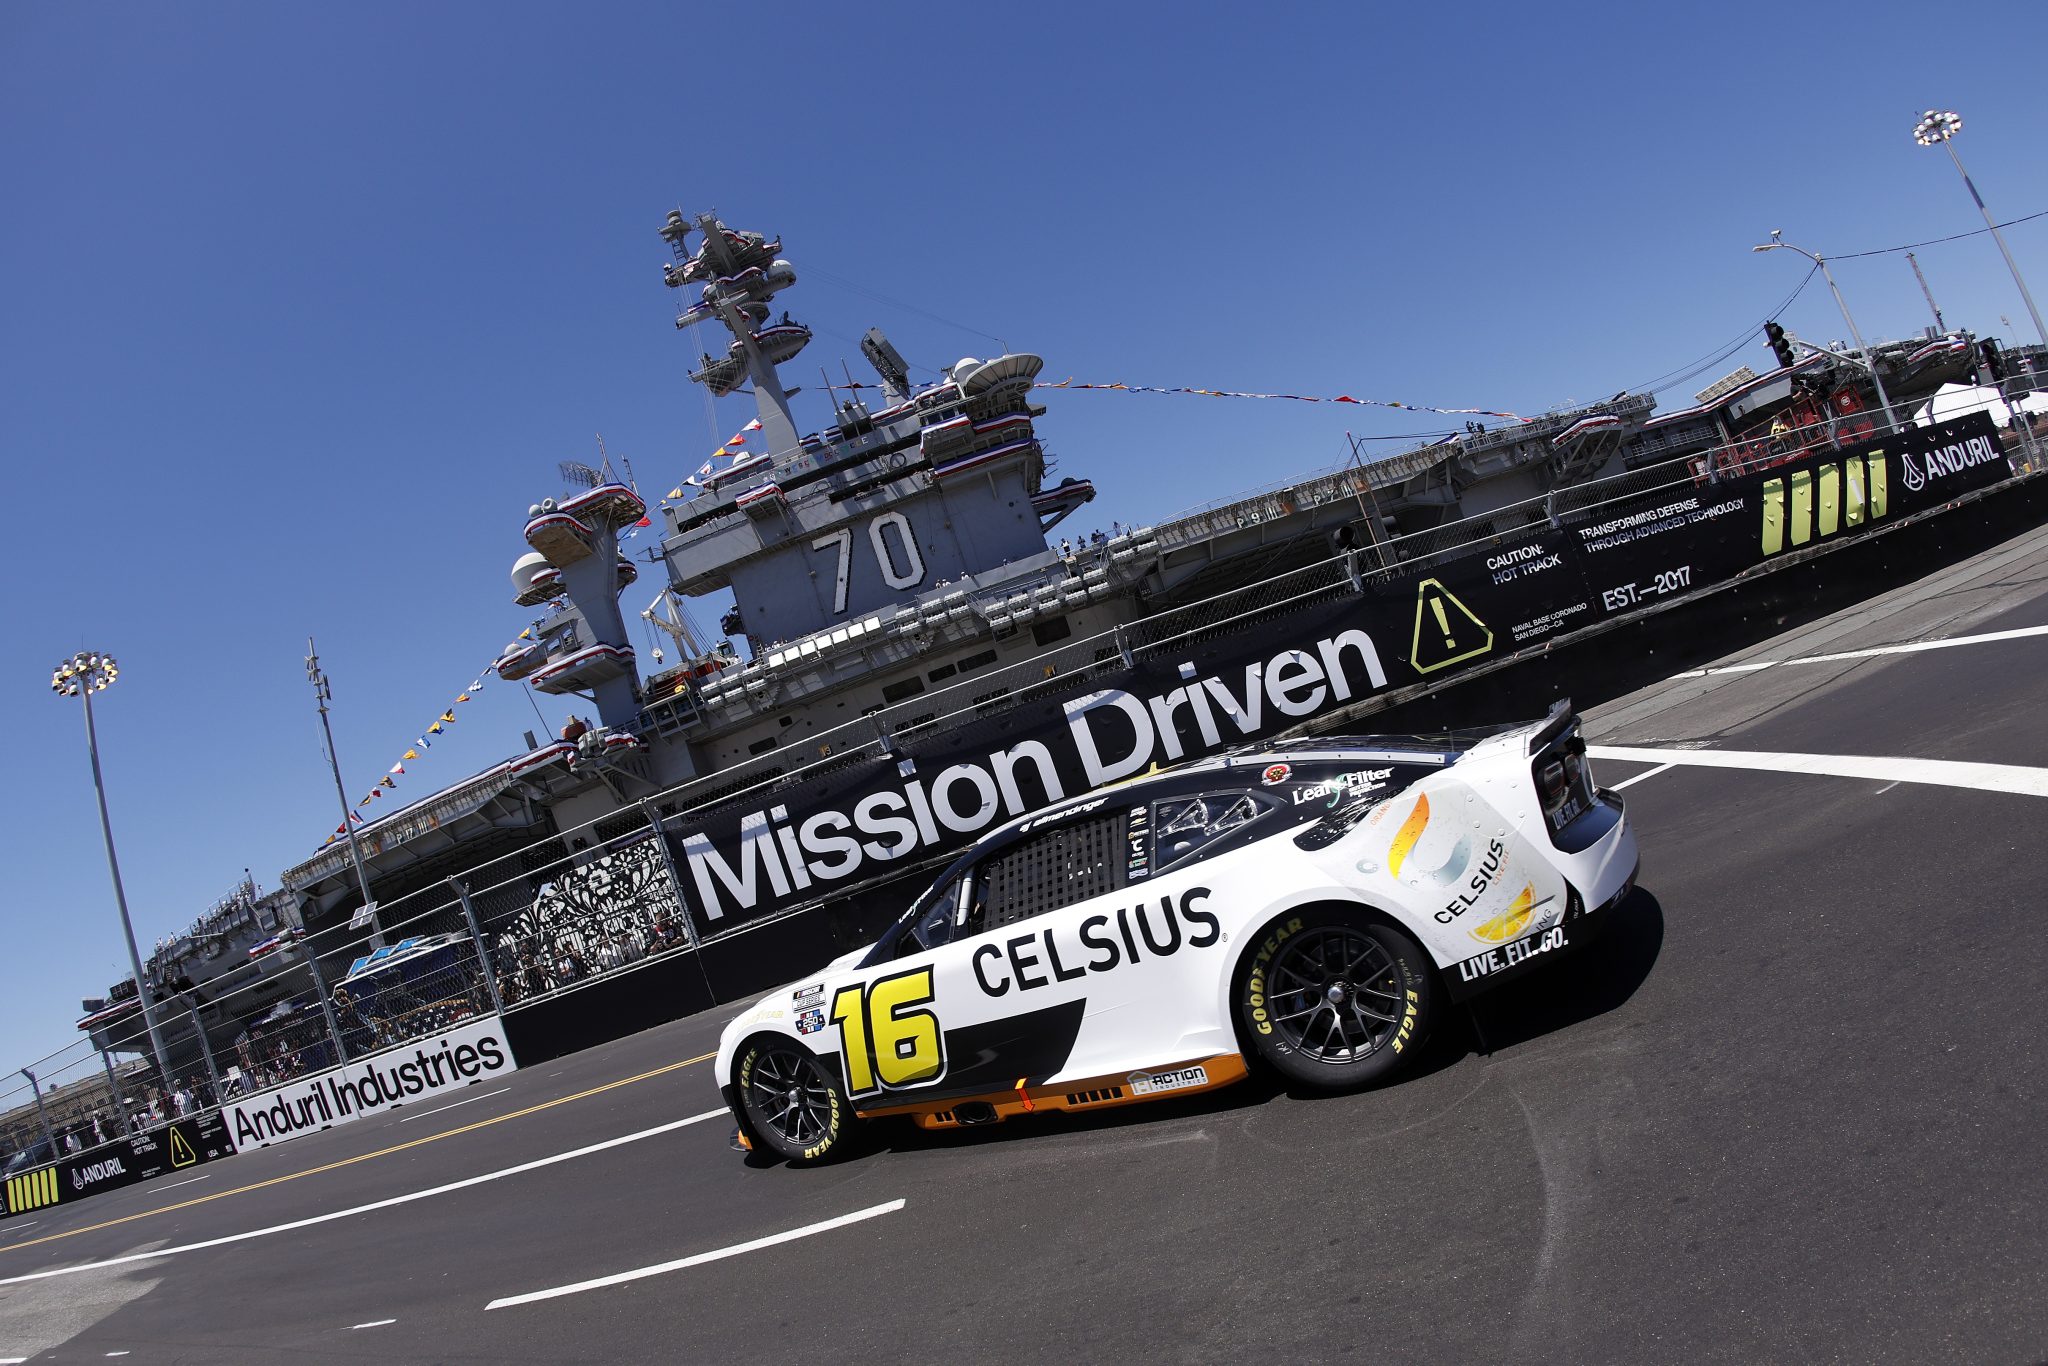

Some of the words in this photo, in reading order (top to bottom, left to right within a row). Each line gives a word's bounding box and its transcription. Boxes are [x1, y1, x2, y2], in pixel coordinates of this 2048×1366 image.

[1924, 435, 2000, 481] ANDURIL
[1251, 511, 1261, 524] 9
[1578, 510, 1657, 540] TRANSFORMING
[1656, 498, 1700, 519] DEFENSE
[1584, 530, 1635, 553] THROUGH
[1636, 516, 1686, 540] ADVANCED
[1685, 498, 1745, 524] TECHNOLOGY
[811, 511, 927, 615] 70
[1486, 543, 1545, 570] CAUTION:
[1492, 567, 1518, 585] HOT
[1519, 553, 1562, 576] TRACK
[1512, 621, 1534, 634] NAVAL
[1532, 614, 1551, 626] BASE
[1550, 602, 1588, 620] CORONADO
[1514, 630, 1530, 642] SAN
[681, 739, 1065, 921] Mission
[1062, 628, 1389, 788] Driven
[1433, 838, 1504, 925] CELSIUS
[971, 886, 1222, 998] CELSIUS
[1249, 917, 1304, 1036] GOODYEAR
[1458, 950, 1506, 982] LIVE.
[802, 1016, 818, 1027] 250
[829, 963, 948, 1101] 16
[1391, 989, 1419, 1055] EAGLE
[741, 1047, 758, 1089] EAGLE
[1152, 1067, 1205, 1086] ACTION
[1155, 1077, 1207, 1091] INDUSTRIES
[234, 1081, 334, 1147] Anduril
[328, 1036, 505, 1116] Industries
[804, 1087, 840, 1159] GOODYEAR
[143, 1142, 158, 1153] TRACK
[207, 1148, 219, 1158] USA
[82, 1157, 127, 1185] ANDURIL
